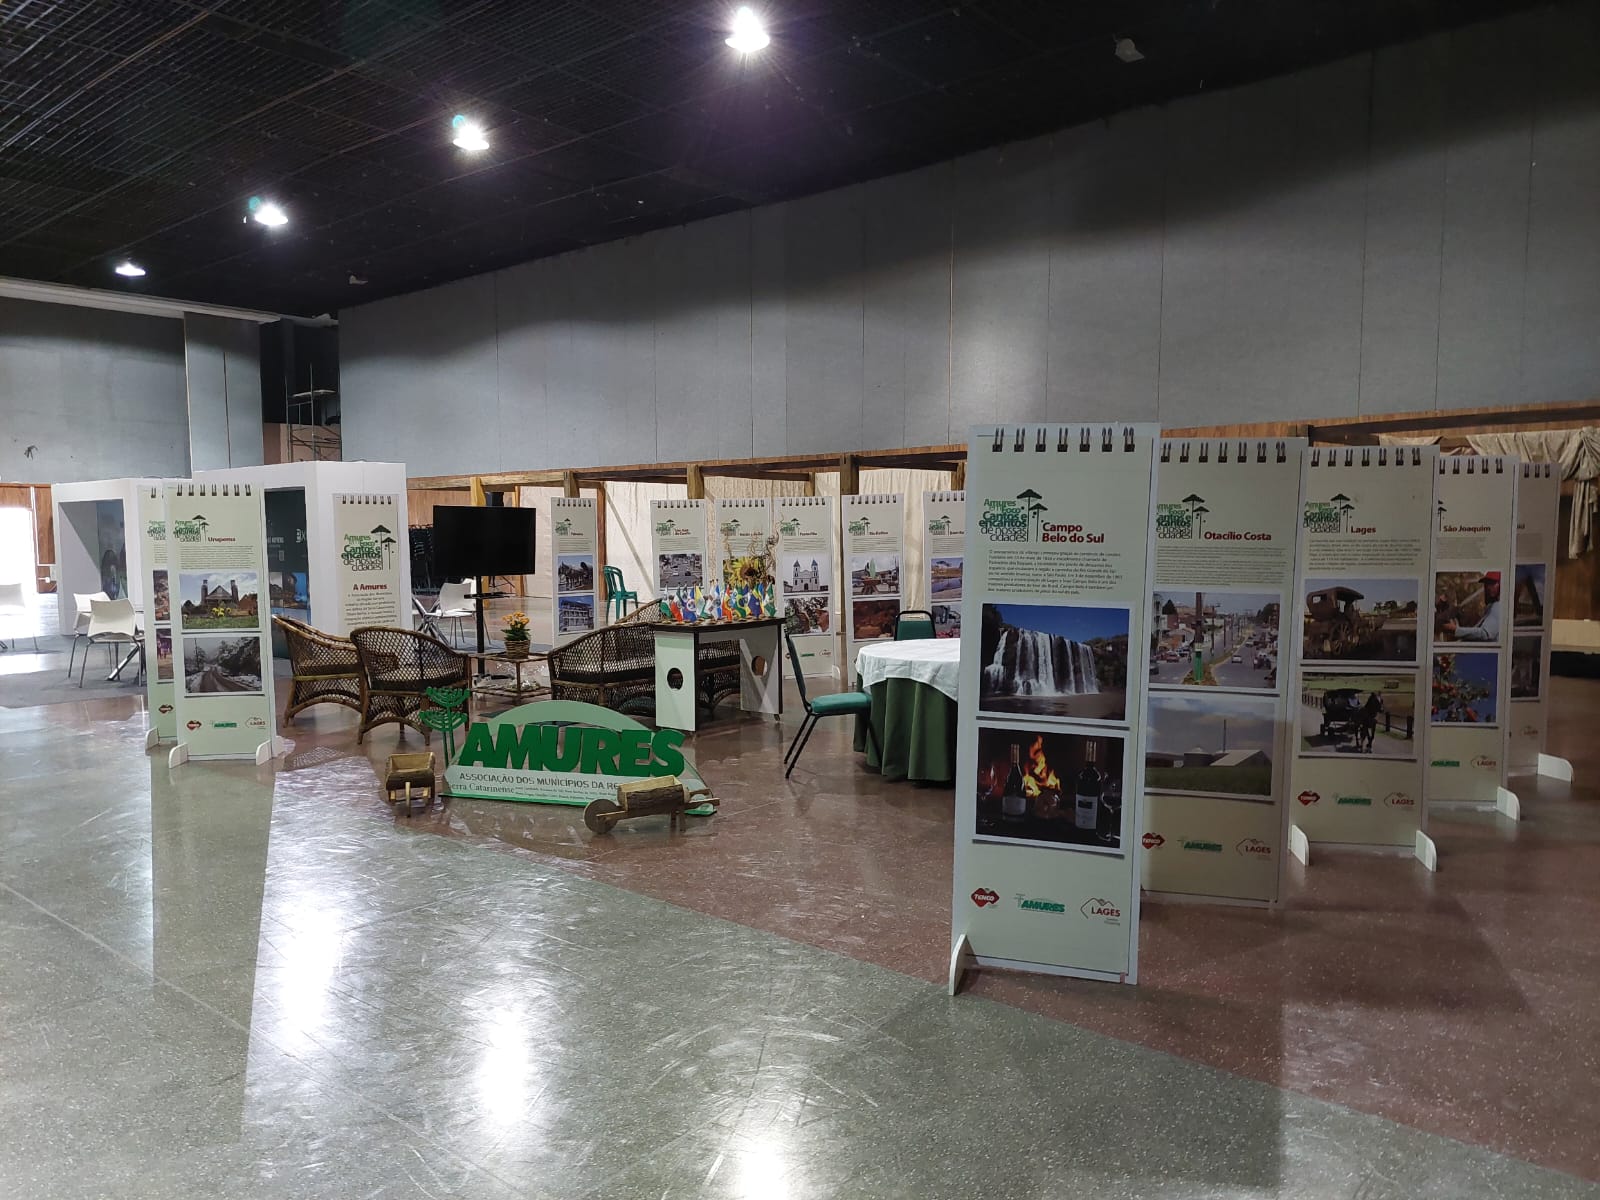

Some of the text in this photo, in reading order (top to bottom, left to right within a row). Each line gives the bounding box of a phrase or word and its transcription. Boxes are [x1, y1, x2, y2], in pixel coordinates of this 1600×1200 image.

[984, 499, 1016, 507] Amures
[983, 511, 1027, 521] Cantos e
[979, 519, 1027, 528] encantos
[1042, 522, 1083, 534] Campo
[981, 526, 993, 534] de
[1351, 526, 1376, 535] Lages
[1443, 524, 1491, 534] São Joaquim
[990, 533, 1027, 542] cidades
[1042, 533, 1105, 543] Belo do Sul
[1244, 531, 1272, 541] Costa
[360, 583, 388, 591] Amures
[457, 722, 686, 778] AMURES
[459, 772, 514, 784] ASSOCIAÇÃO
[516, 775, 535, 785] DOS
[536, 775, 590, 788] MUNICÍPIOS
[591, 780, 605, 789] DA
[469, 782, 515, 793] Catarinense
[1245, 846, 1271, 854] LAGES
[1021, 899, 1065, 912] AMURES
[1091, 906, 1121, 918] LAGES
